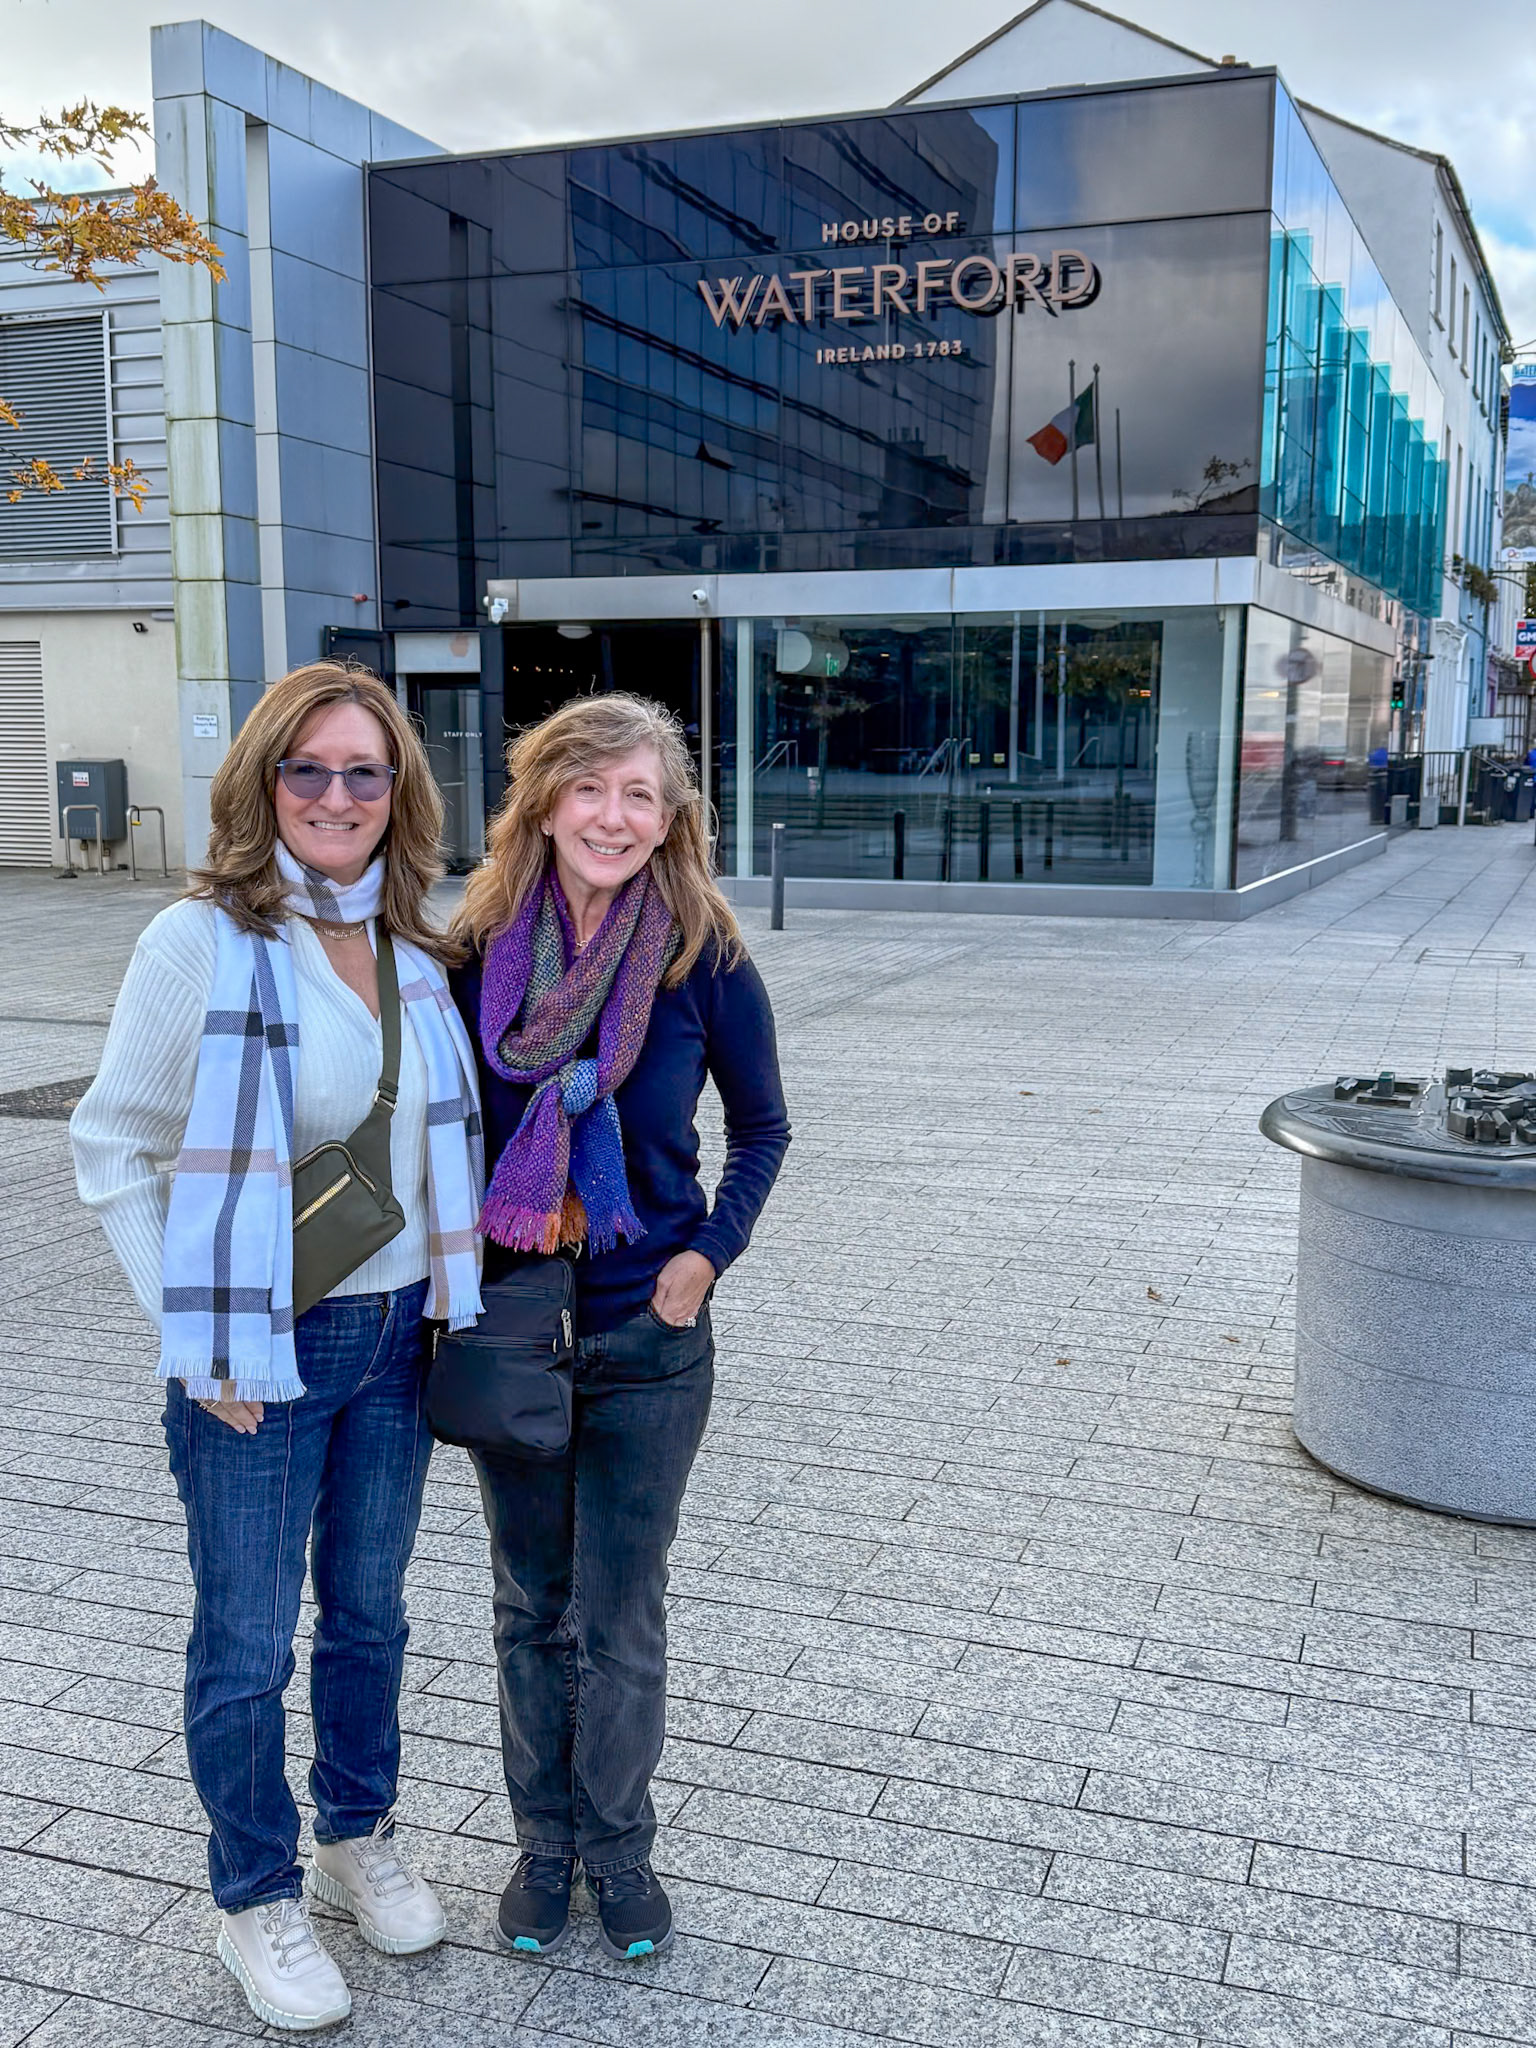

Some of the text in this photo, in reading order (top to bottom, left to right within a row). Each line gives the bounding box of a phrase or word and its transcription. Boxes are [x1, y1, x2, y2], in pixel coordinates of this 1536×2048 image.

[822, 211, 959, 243] HOUSE OF
[697, 249, 1093, 328] WATERFORD
[816, 339, 962, 364] IRELAND 1783
